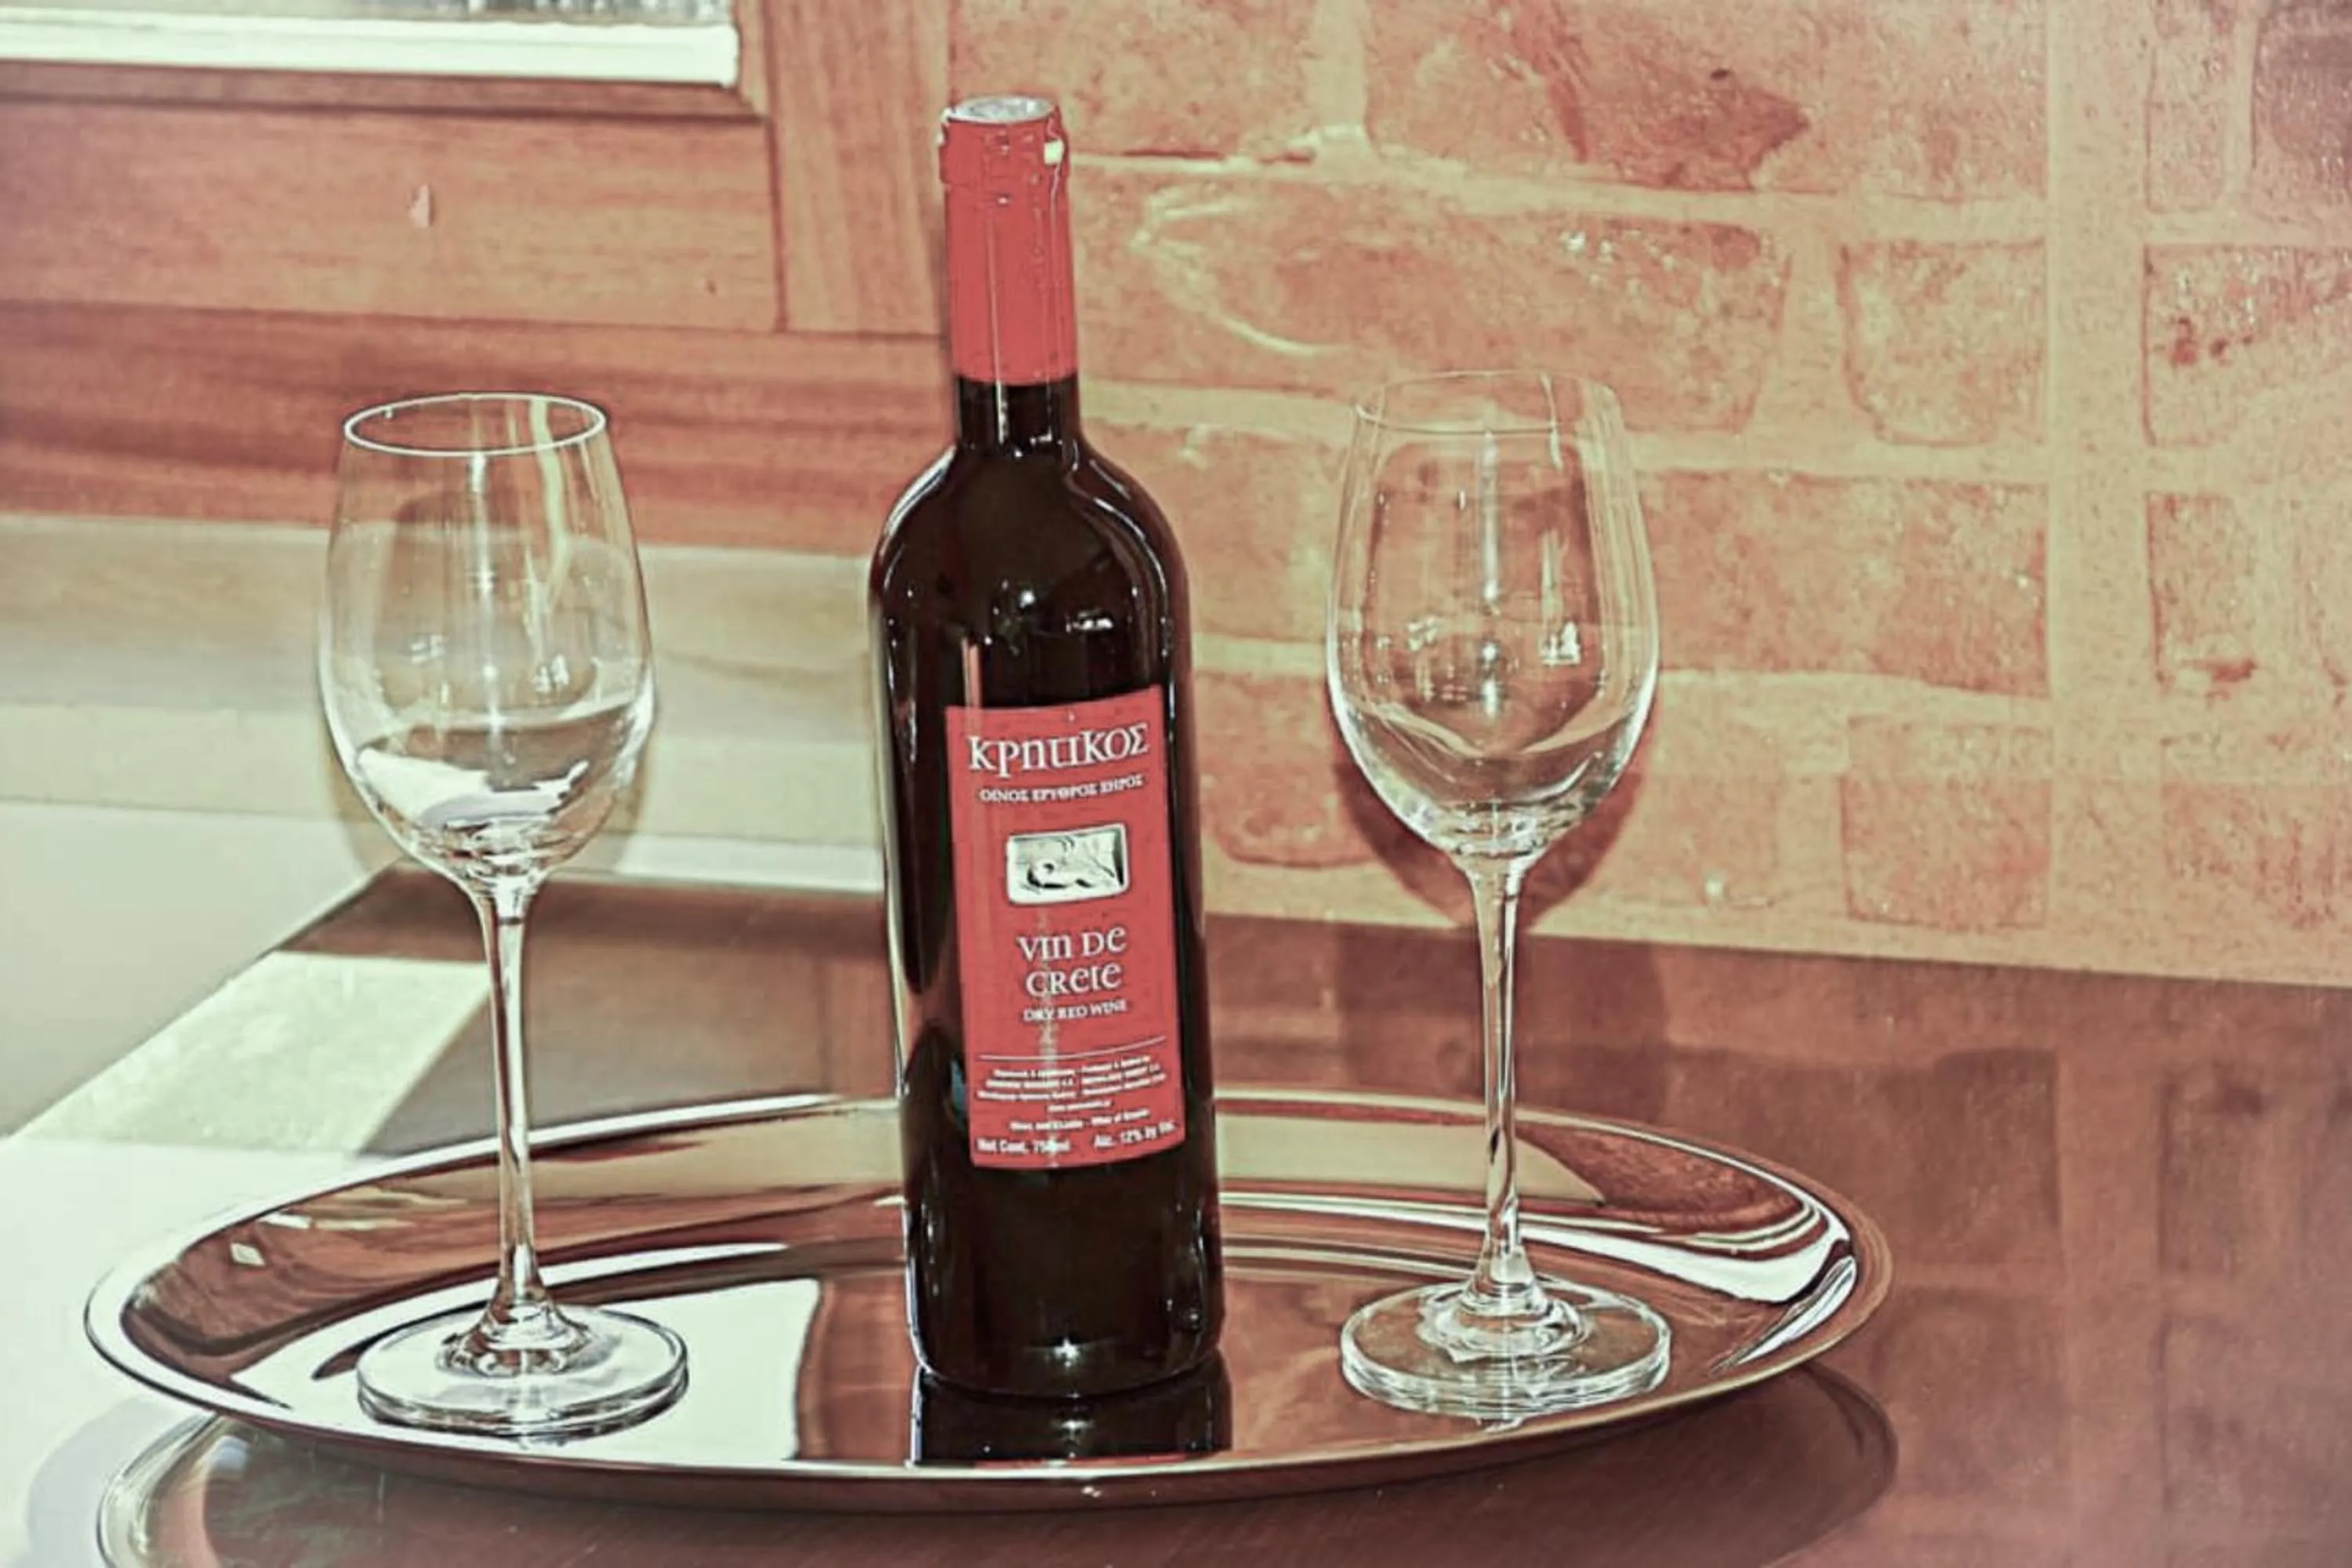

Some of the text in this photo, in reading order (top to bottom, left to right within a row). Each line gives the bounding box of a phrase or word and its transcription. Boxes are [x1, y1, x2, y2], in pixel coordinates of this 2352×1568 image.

[1023, 999, 1127, 1022] DRY RED WINE
